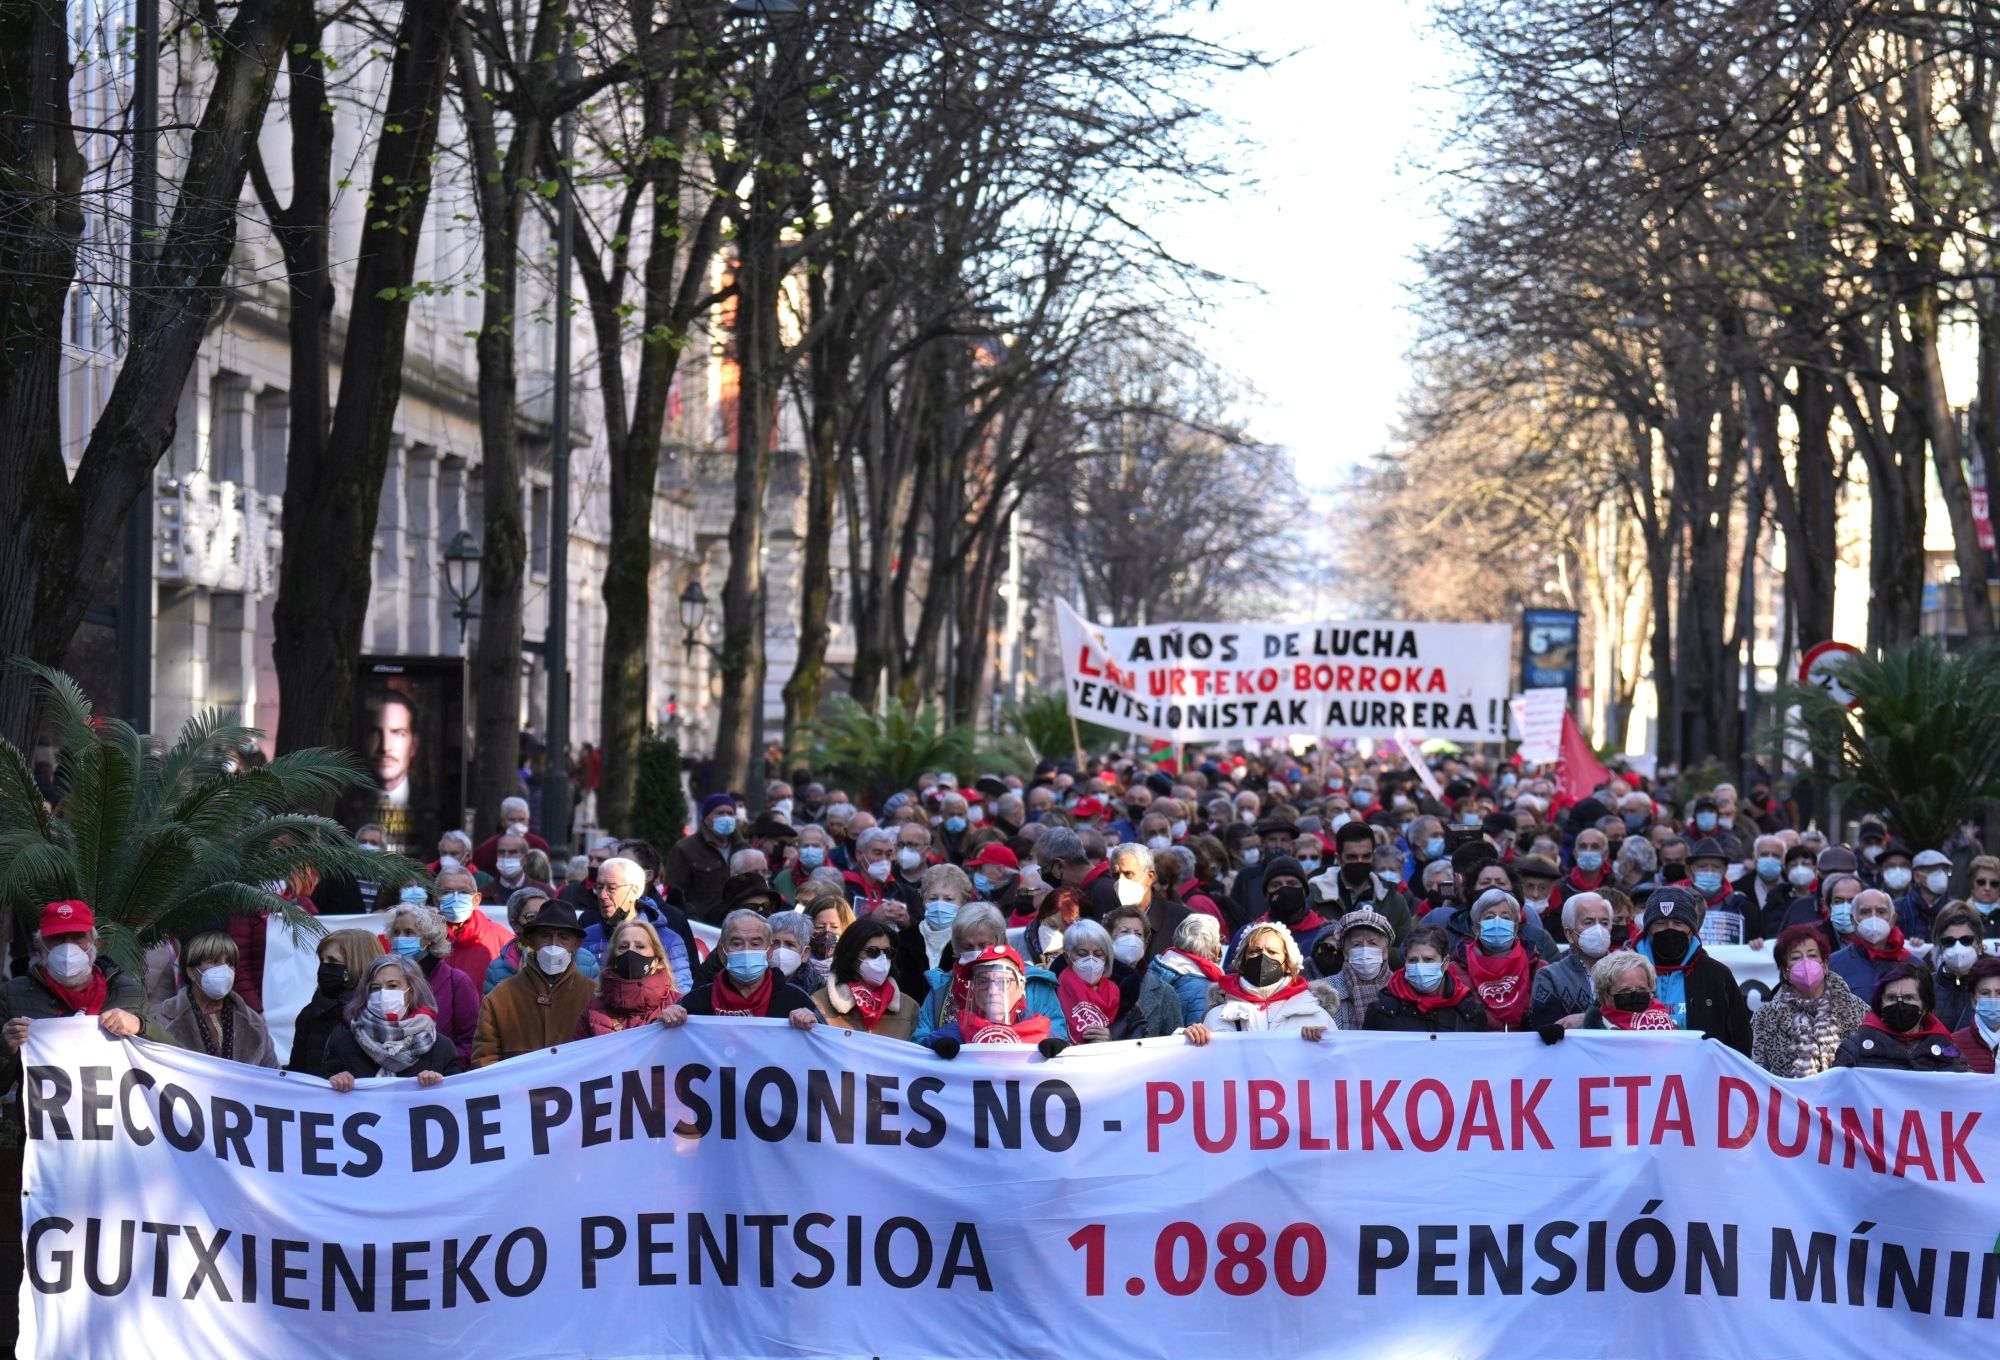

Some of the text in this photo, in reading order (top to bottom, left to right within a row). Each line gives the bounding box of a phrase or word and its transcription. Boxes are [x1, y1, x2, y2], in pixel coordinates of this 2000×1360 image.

[1128, 625, 1239, 661] AÑOS
[1264, 632, 1300, 658] DE
[1313, 629, 1418, 658] LUCHA
[1148, 667, 1279, 697] URTEKO
[1294, 664, 1447, 693] BORROKA
[1326, 700, 1478, 731] AURRERA
[27, 1066, 383, 1178] RECORTES
[410, 1095, 504, 1173] DE
[529, 1064, 947, 1155] PENSIONES
[973, 1079, 1081, 1152] NO
[1146, 1079, 1554, 1153] PUBLIKOAK
[1579, 1075, 1695, 1148] ETA
[1718, 1076, 1985, 1184] DUINAK
[26, 1216, 547, 1313] GUTXIENEKO
[580, 1212, 993, 1292] PENTSIOA
[1067, 1222, 1327, 1297] 1.080
[1357, 1199, 1739, 1297] PENSIÓN
